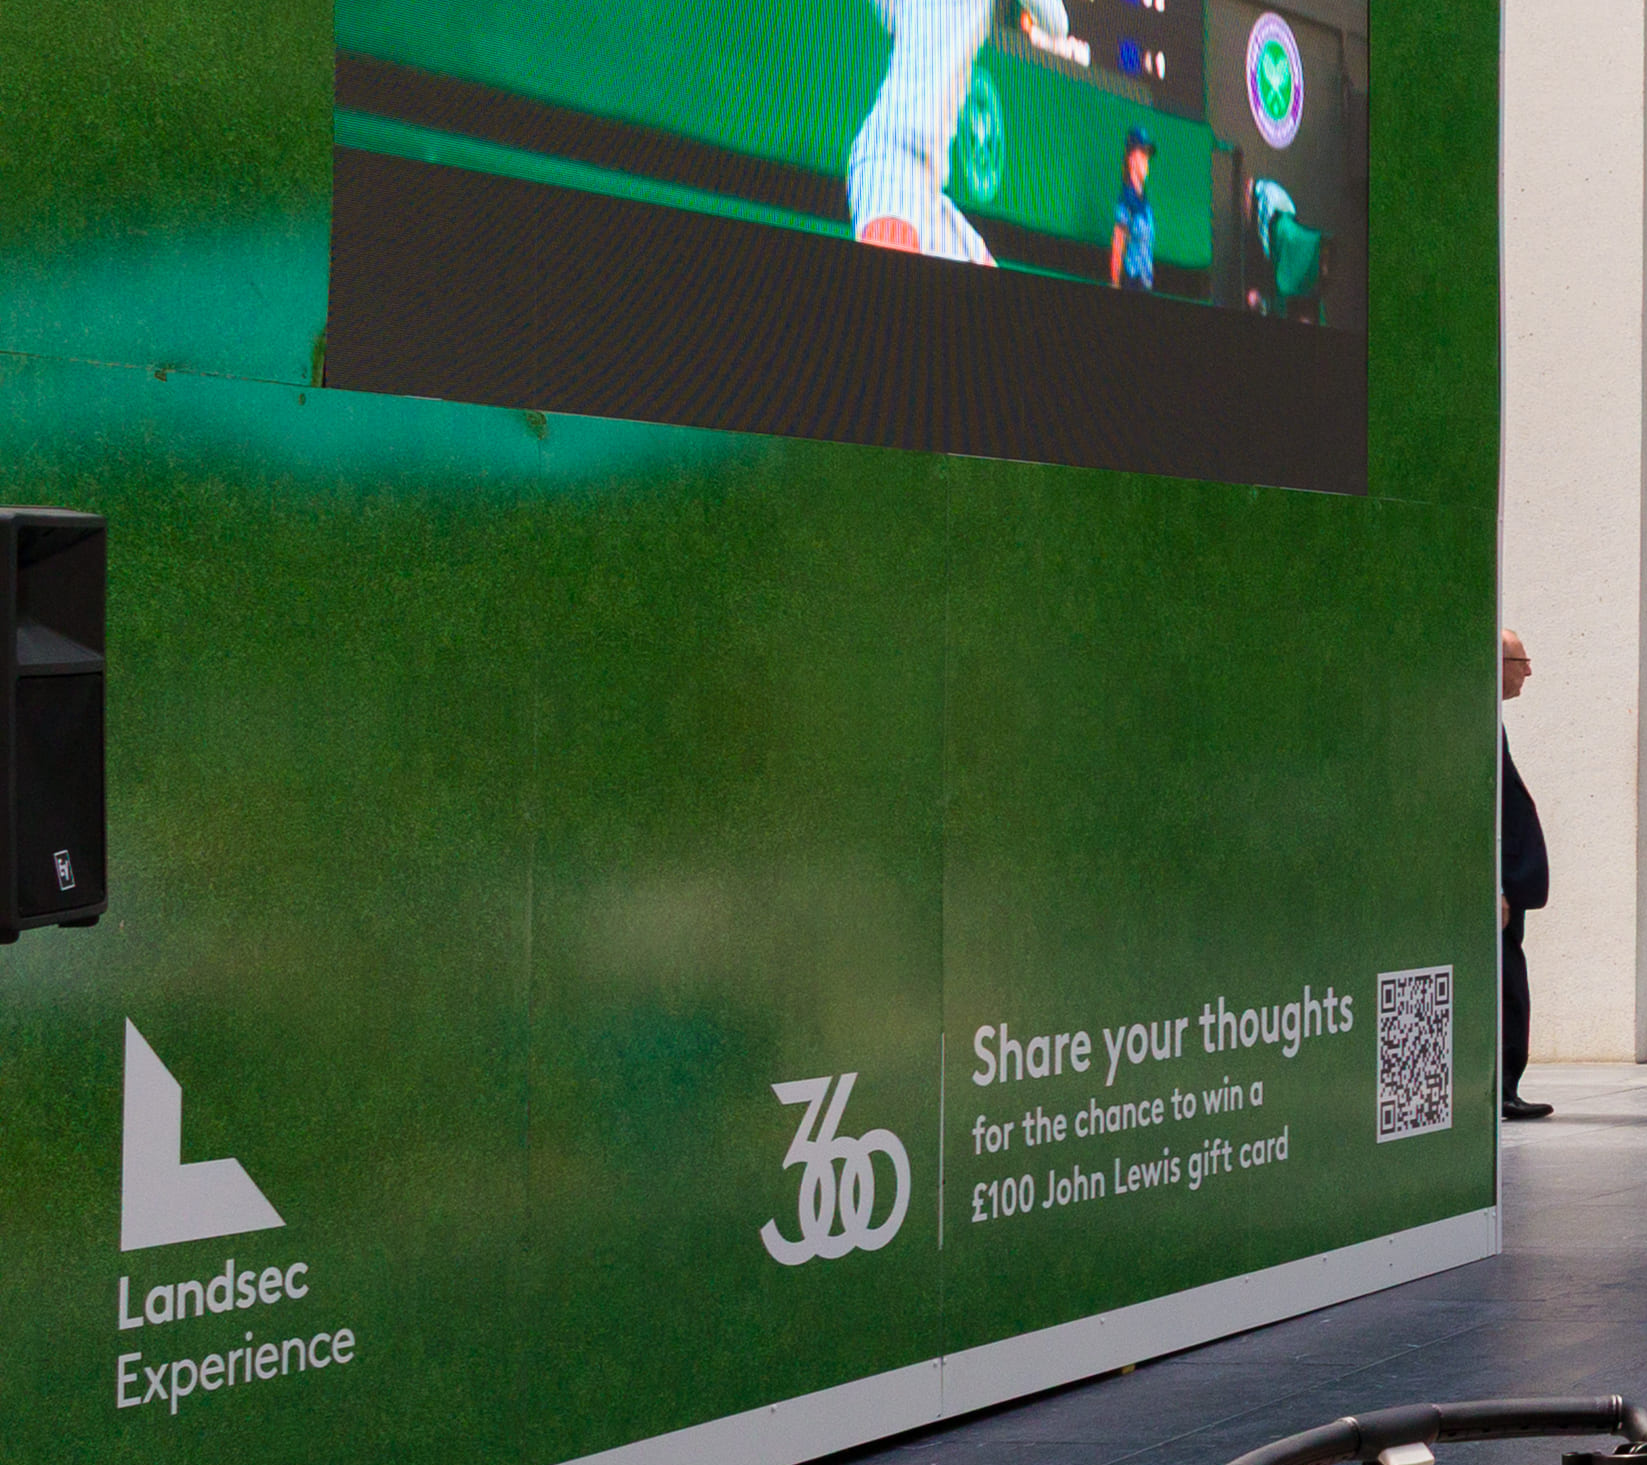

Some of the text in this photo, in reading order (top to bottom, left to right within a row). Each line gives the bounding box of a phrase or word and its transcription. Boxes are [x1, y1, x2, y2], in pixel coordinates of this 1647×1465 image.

[973, 985, 1353, 1086] Share your thoughts
[972, 1080, 1265, 1156] for the chance to win a
[972, 1127, 1290, 1223] £100 John Lewis gift card
[118, 1258, 309, 1331] Landsec
[116, 1327, 356, 1416] Experience
